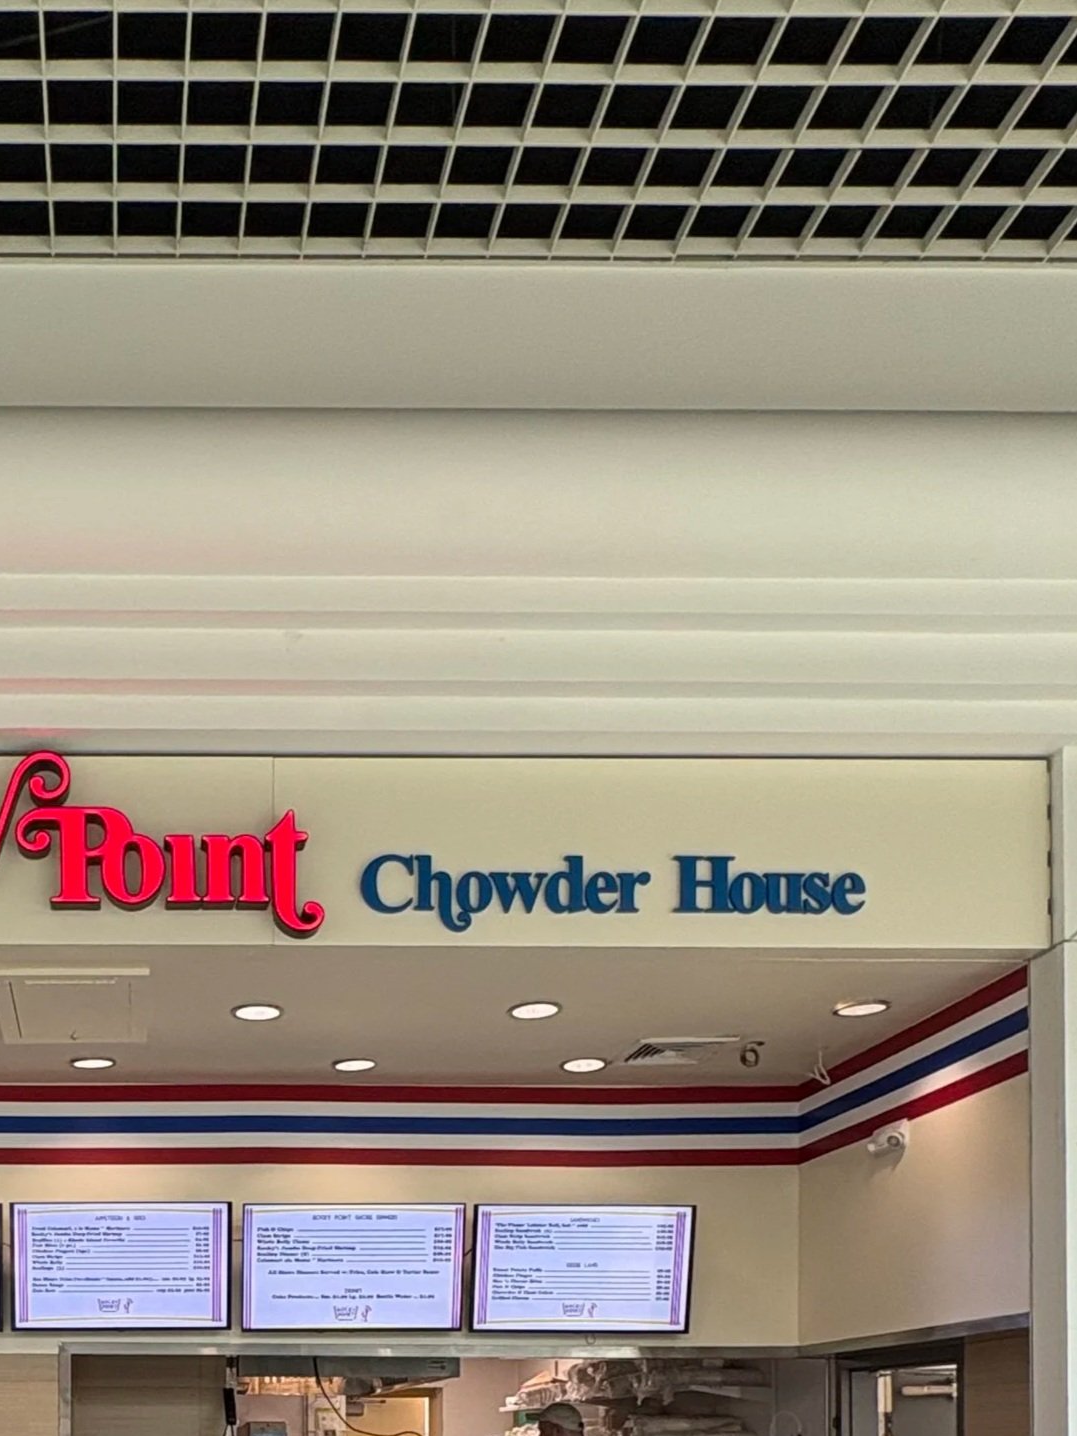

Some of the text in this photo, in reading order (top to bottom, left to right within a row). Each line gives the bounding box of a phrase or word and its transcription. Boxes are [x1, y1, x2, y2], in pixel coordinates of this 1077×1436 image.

[16, 806, 324, 936] Point
[359, 853, 866, 932] Chowder House
